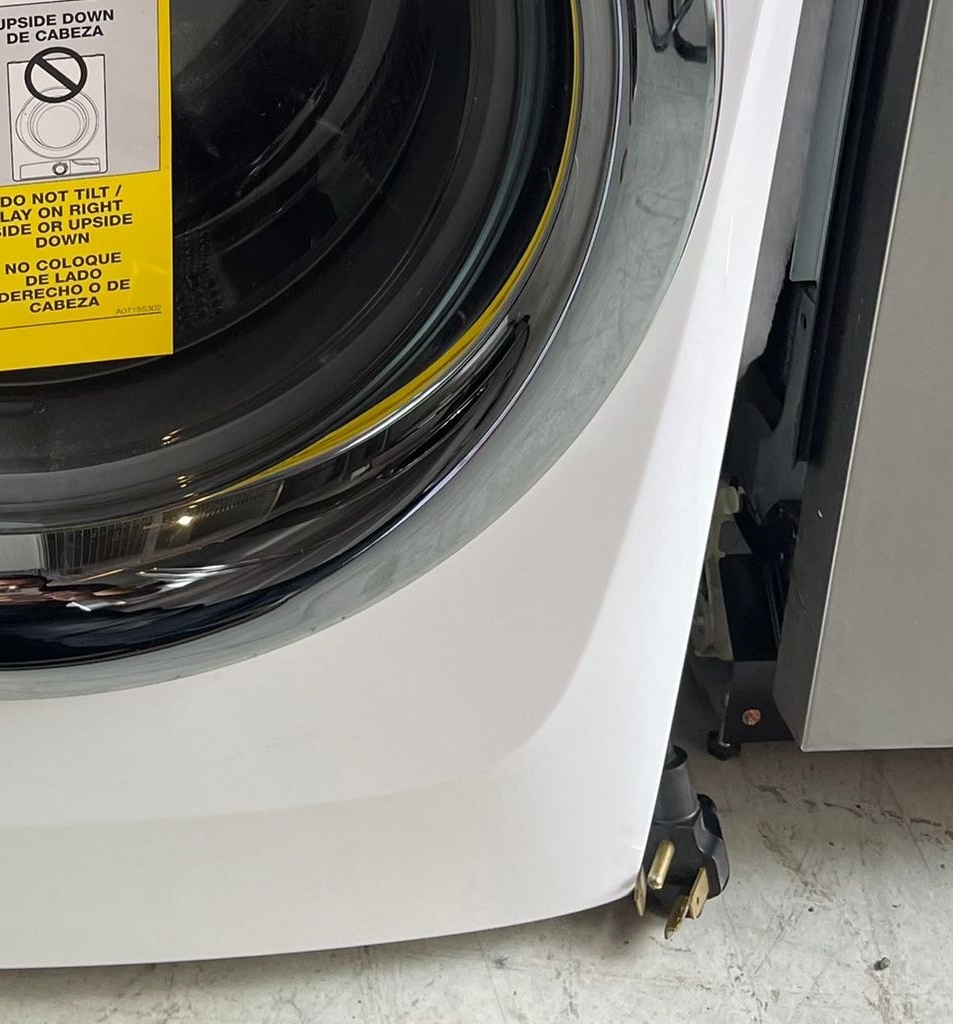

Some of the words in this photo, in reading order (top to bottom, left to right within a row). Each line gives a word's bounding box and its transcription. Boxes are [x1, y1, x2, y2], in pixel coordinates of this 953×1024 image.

[63, 9, 114, 26] DOWN
[7, 32, 30, 44] DE
[35, 26, 104, 42] CABEZA
[0, 195, 26, 207] DO
[32, 190, 69, 204] NOT
[74, 186, 110, 200] TILT
[115, 185, 122, 196] /
[0, 209, 32, 222] LAY
[38, 206, 63, 219] ON
[70, 200, 123, 216] RIGHT
[37, 221, 63, 234] OR
[69, 213, 133, 230] UPSIDE
[35, 232, 90, 248] DOWN
[5, 262, 30, 275] NO
[36, 252, 122, 272] COLOQUE
[26, 274, 49, 286] DE
[55, 268, 102, 284] LADO
[89, 282, 101, 294] O
[107, 279, 130, 291] DE
[30, 297, 100, 313] CABEZA
